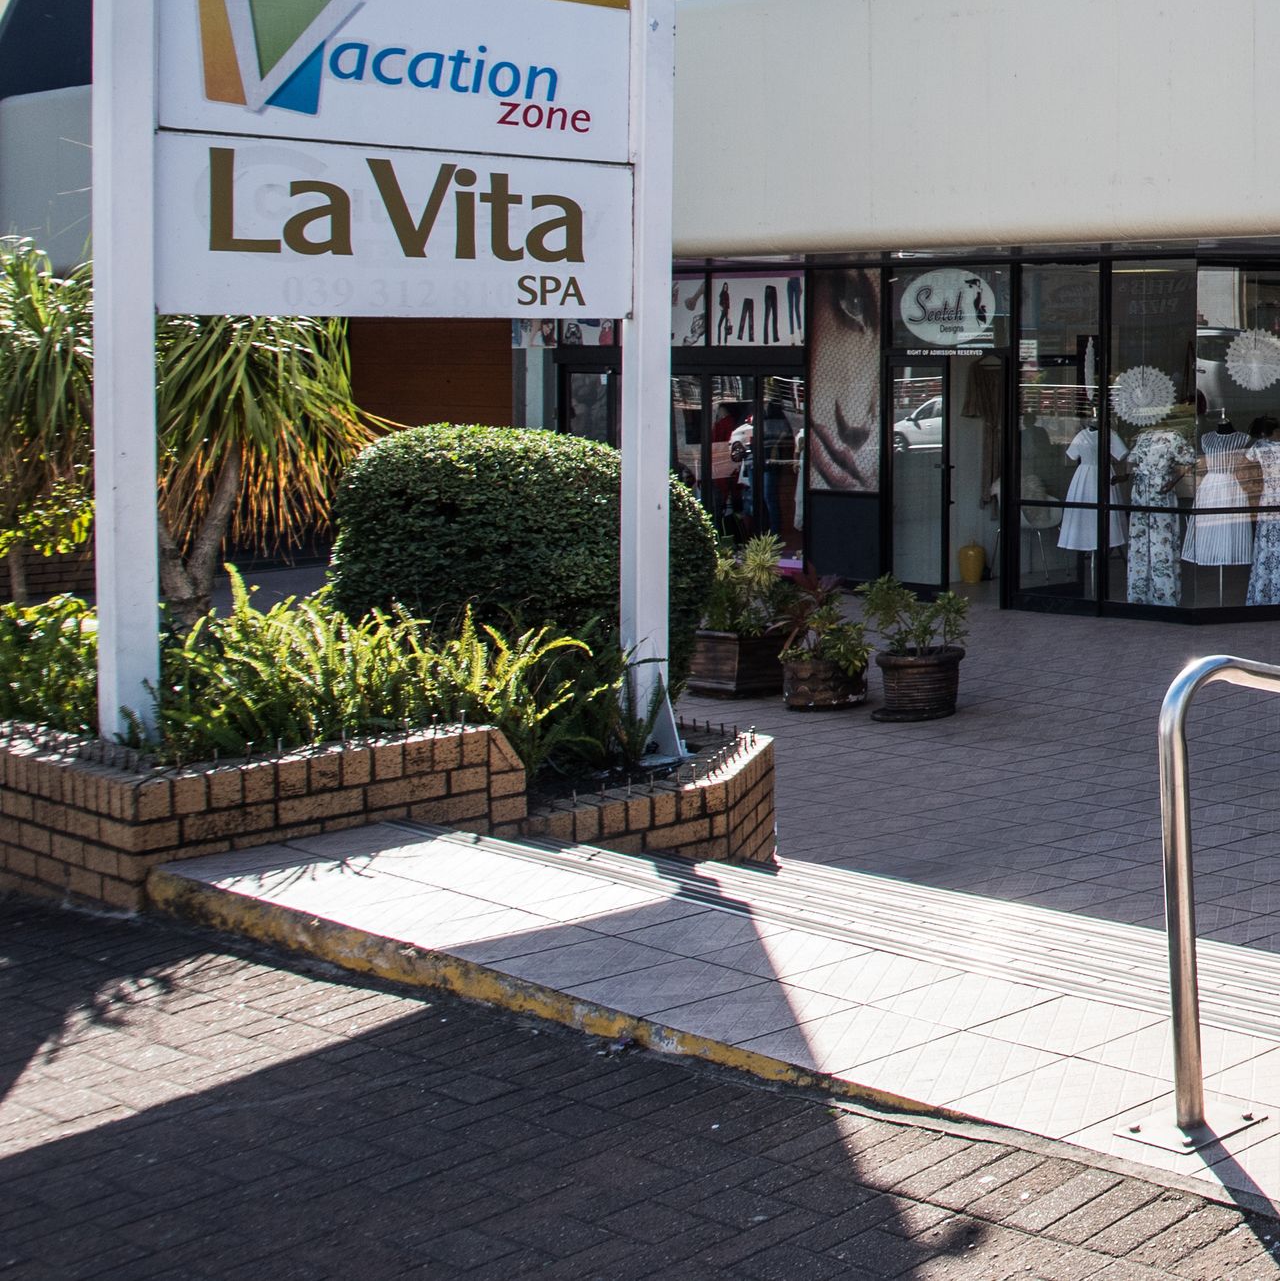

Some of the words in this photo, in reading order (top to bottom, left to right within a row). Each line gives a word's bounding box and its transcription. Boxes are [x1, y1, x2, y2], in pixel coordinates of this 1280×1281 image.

[496, 101, 591, 133] zone
[517, 275, 586, 308] SPA
[908, 286, 965, 324] Scotch
[940, 324, 965, 334] Designs
